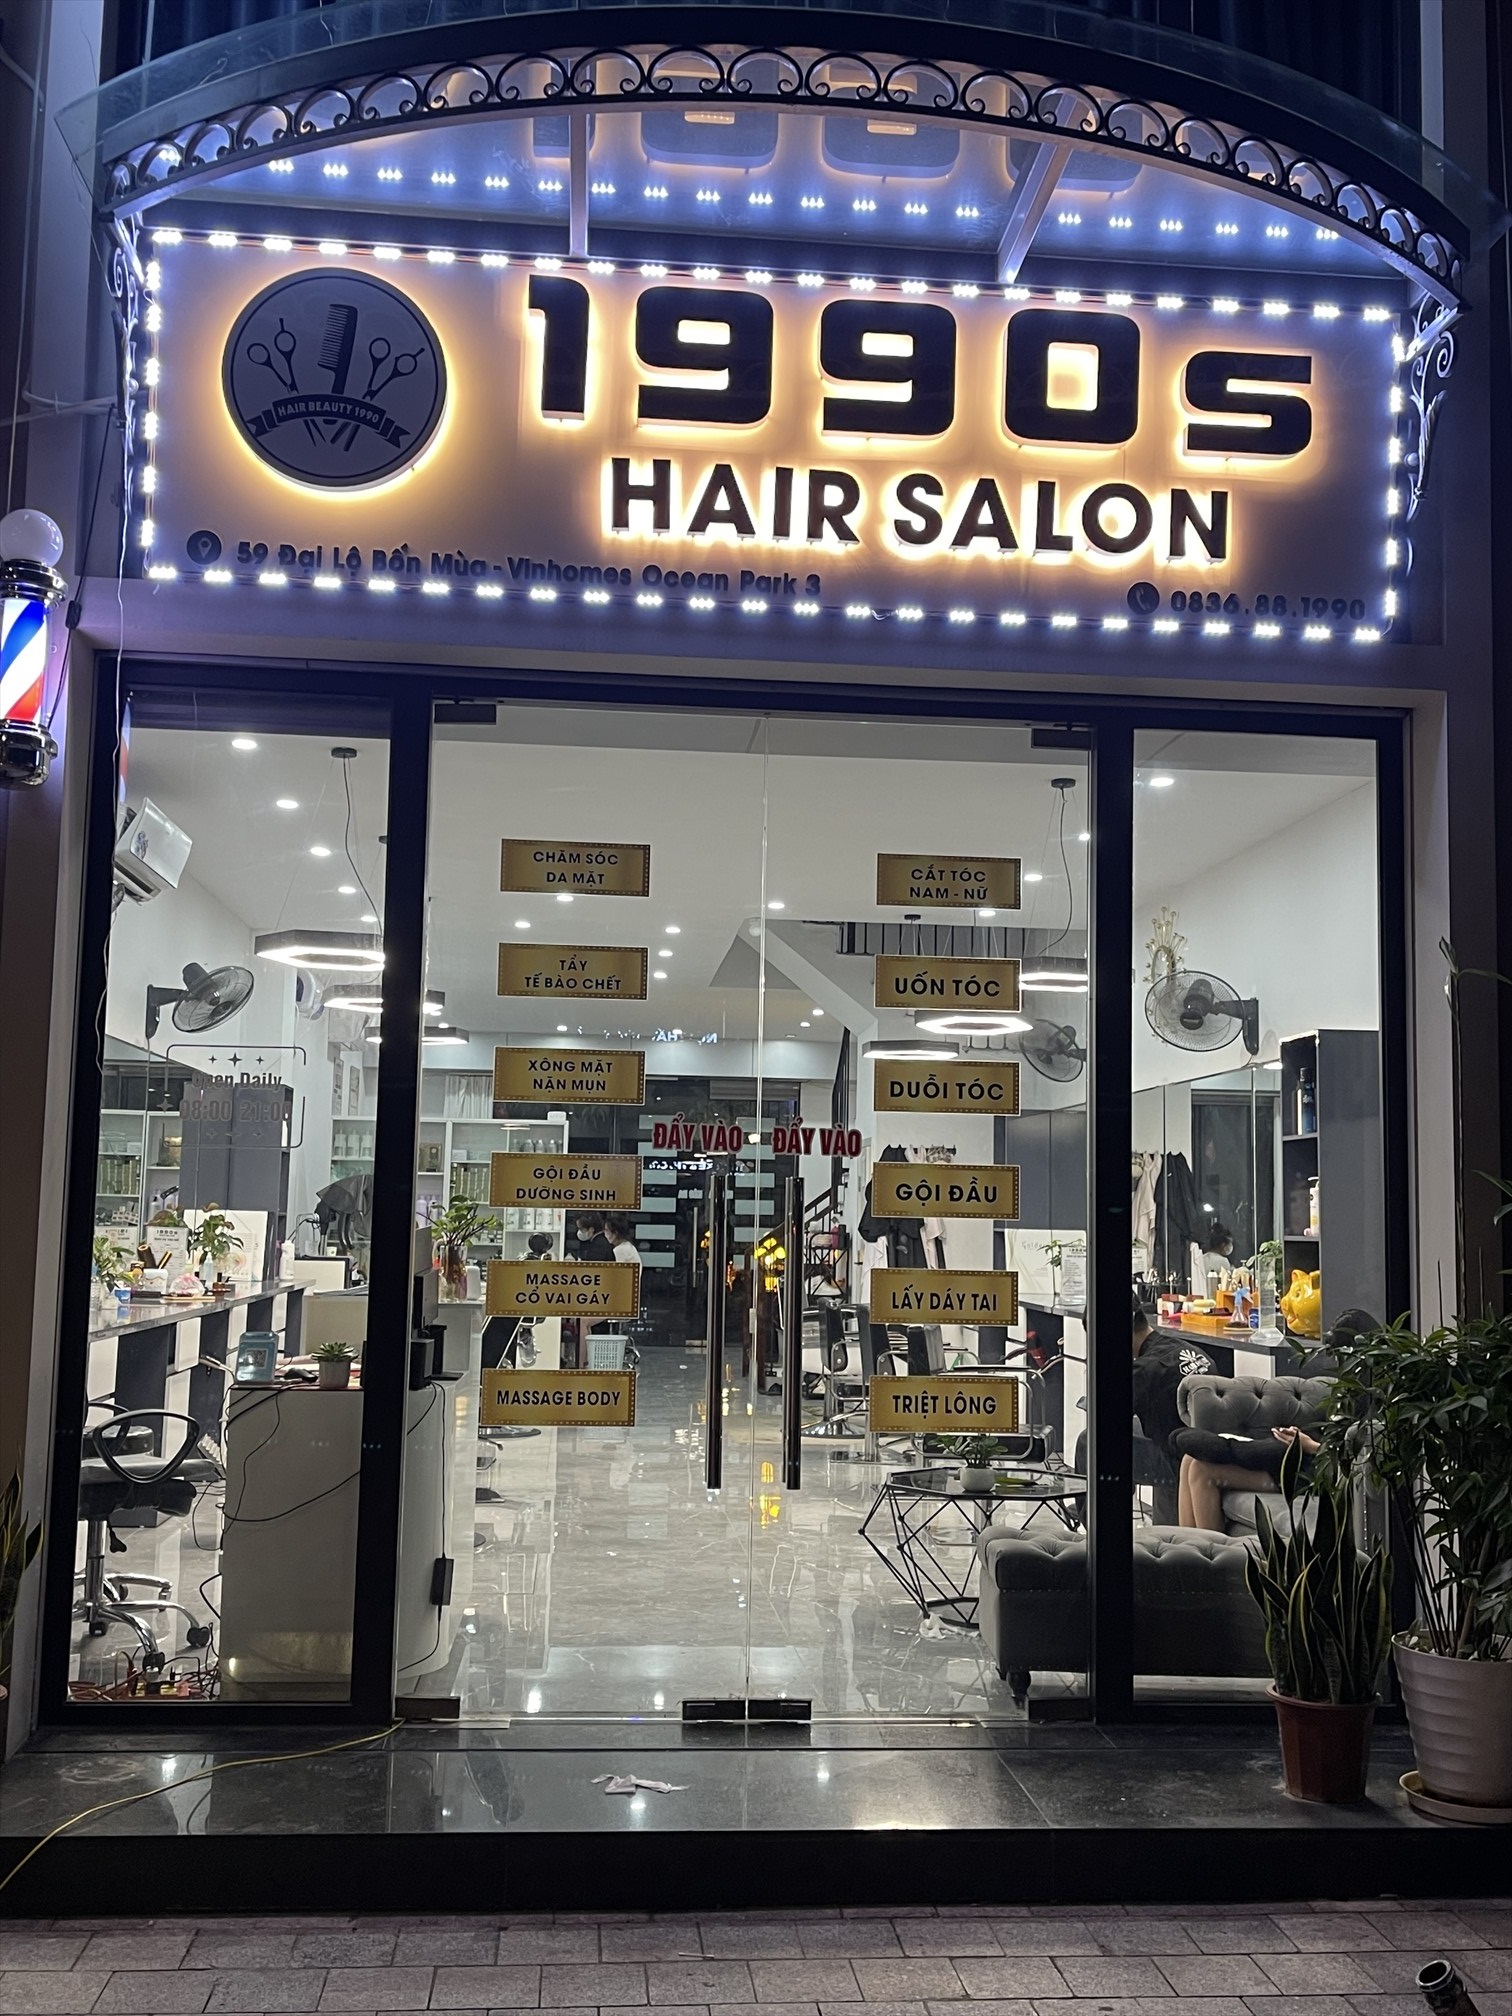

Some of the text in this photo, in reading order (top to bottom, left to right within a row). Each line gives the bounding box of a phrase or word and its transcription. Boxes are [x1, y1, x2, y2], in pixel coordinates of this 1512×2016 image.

[278, 401, 379, 424] HAIR BEAUTY 1990
[611, 457, 1228, 561] HAIR SALON
[237, 542, 268, 565] 59
[278, 543, 322, 573] Đại
[334, 545, 362, 577] Lộ
[373, 543, 420, 573] Bốn
[431, 550, 486, 577] Mùa
[507, 557, 631, 586] Vinhomes
[642, 565, 728, 591] Ocean
[740, 570, 796, 595] Park
[805, 574, 821, 595] 3
[533, 850, 619, 865] CHĂM SÓC
[546, 872, 605, 888] DA MẶT
[911, 864, 986, 882] CẮT TÓC
[910, 887, 949, 899] NAM
[964, 886, 988, 900] NỮ
[559, 954, 588, 971] TẨY
[524, 972, 622, 991] TẾ BÀO CHẾT
[895, 971, 1000, 997] UỐN TÓC
[528, 1057, 613, 1078] XÔNG MẶT
[240, 1073, 282, 1091] Daily
[533, 1076, 606, 1094] NẶN MỤN
[890, 1074, 1004, 1100] DUỖI TÓC
[653, 1113, 743, 1153] ĐẨY VÀO
[772, 1117, 862, 1157] ĐẨY VÀO
[533, 1165, 563, 1183] GỘI
[516, 1185, 616, 1201] DƯỠNG SINH
[896, 1176, 997, 1206] GỘI ĐẦU
[526, 1273, 601, 1286] MASSAGE
[515, 1287, 610, 1305] CỔ VAI GÁY
[892, 1284, 997, 1311] LẤY DÁY TAI
[497, 1389, 621, 1406] MASSAGE BODY
[892, 1391, 996, 1419] TRIỆT LÔNG
